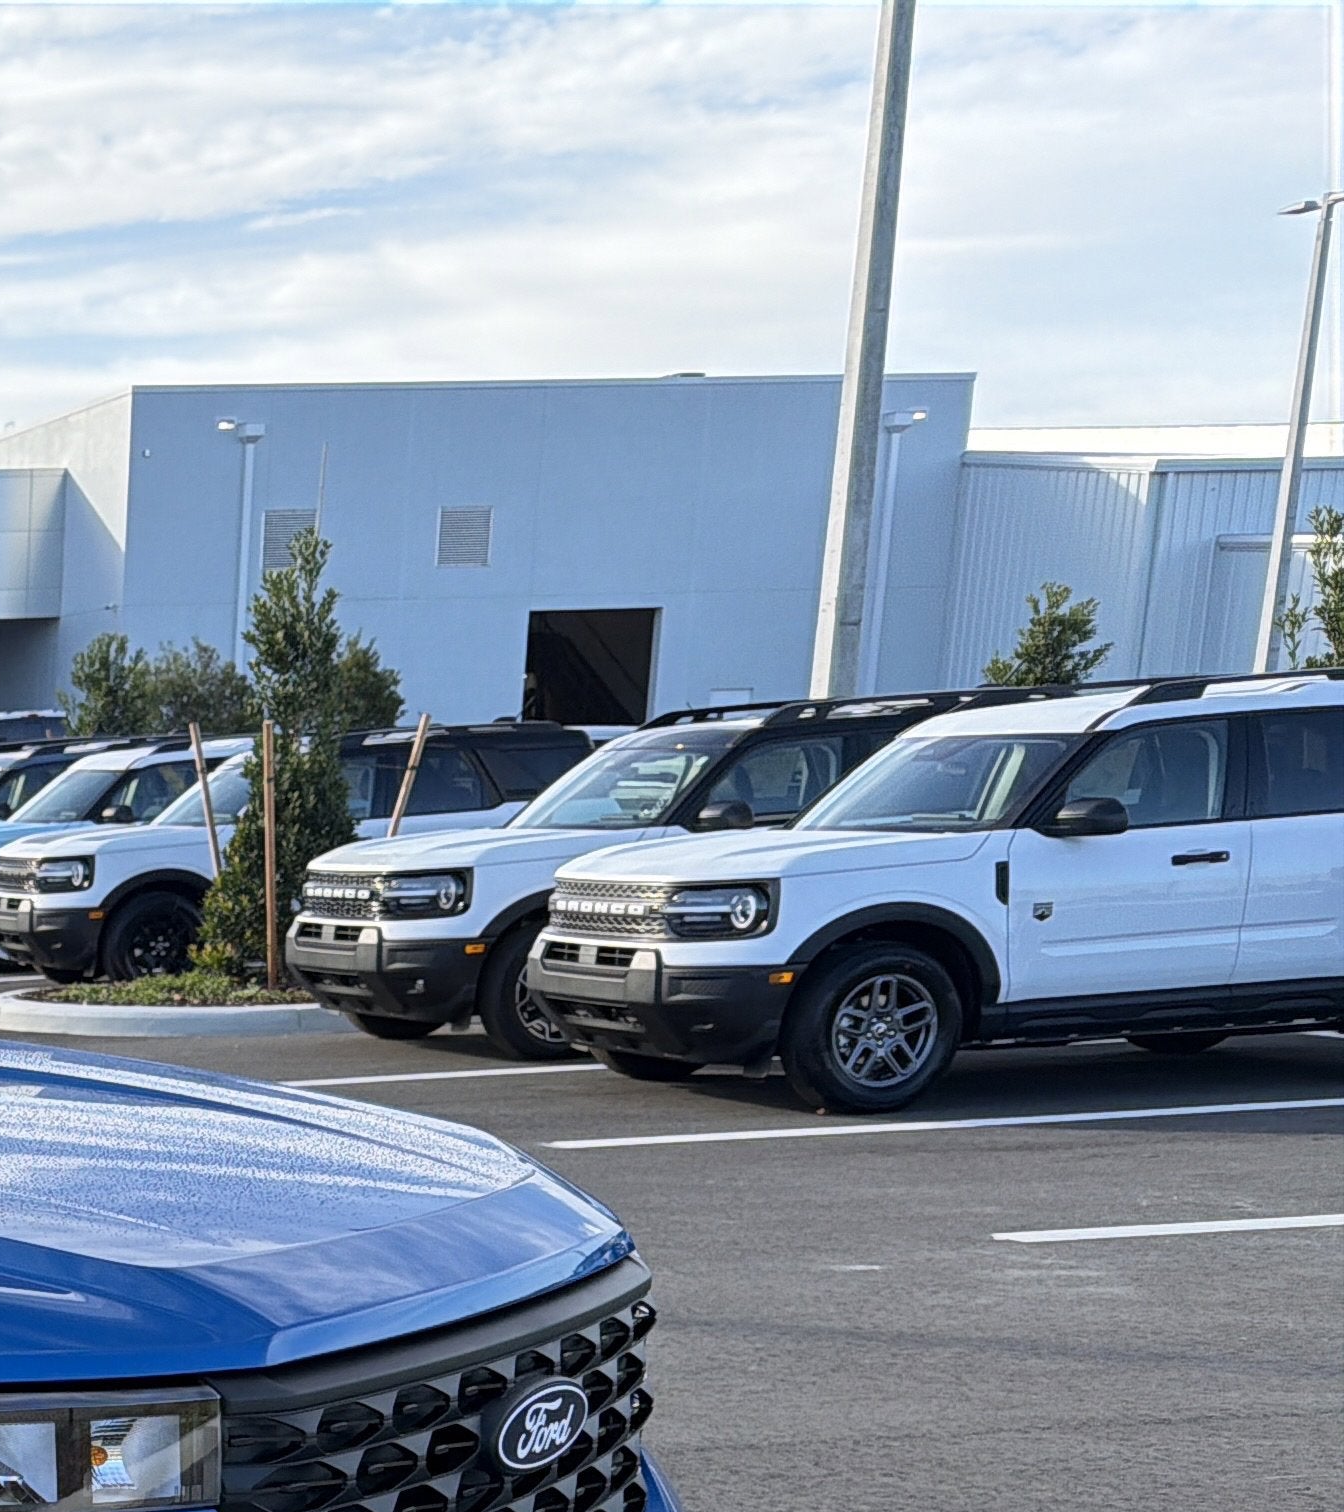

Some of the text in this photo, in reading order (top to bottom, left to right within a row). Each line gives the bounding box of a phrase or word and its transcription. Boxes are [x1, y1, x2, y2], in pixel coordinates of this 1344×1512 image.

[306, 887, 371, 900] BRONCO
[555, 899, 645, 916] BRONCO
[517, 1397, 575, 1459] Ford
